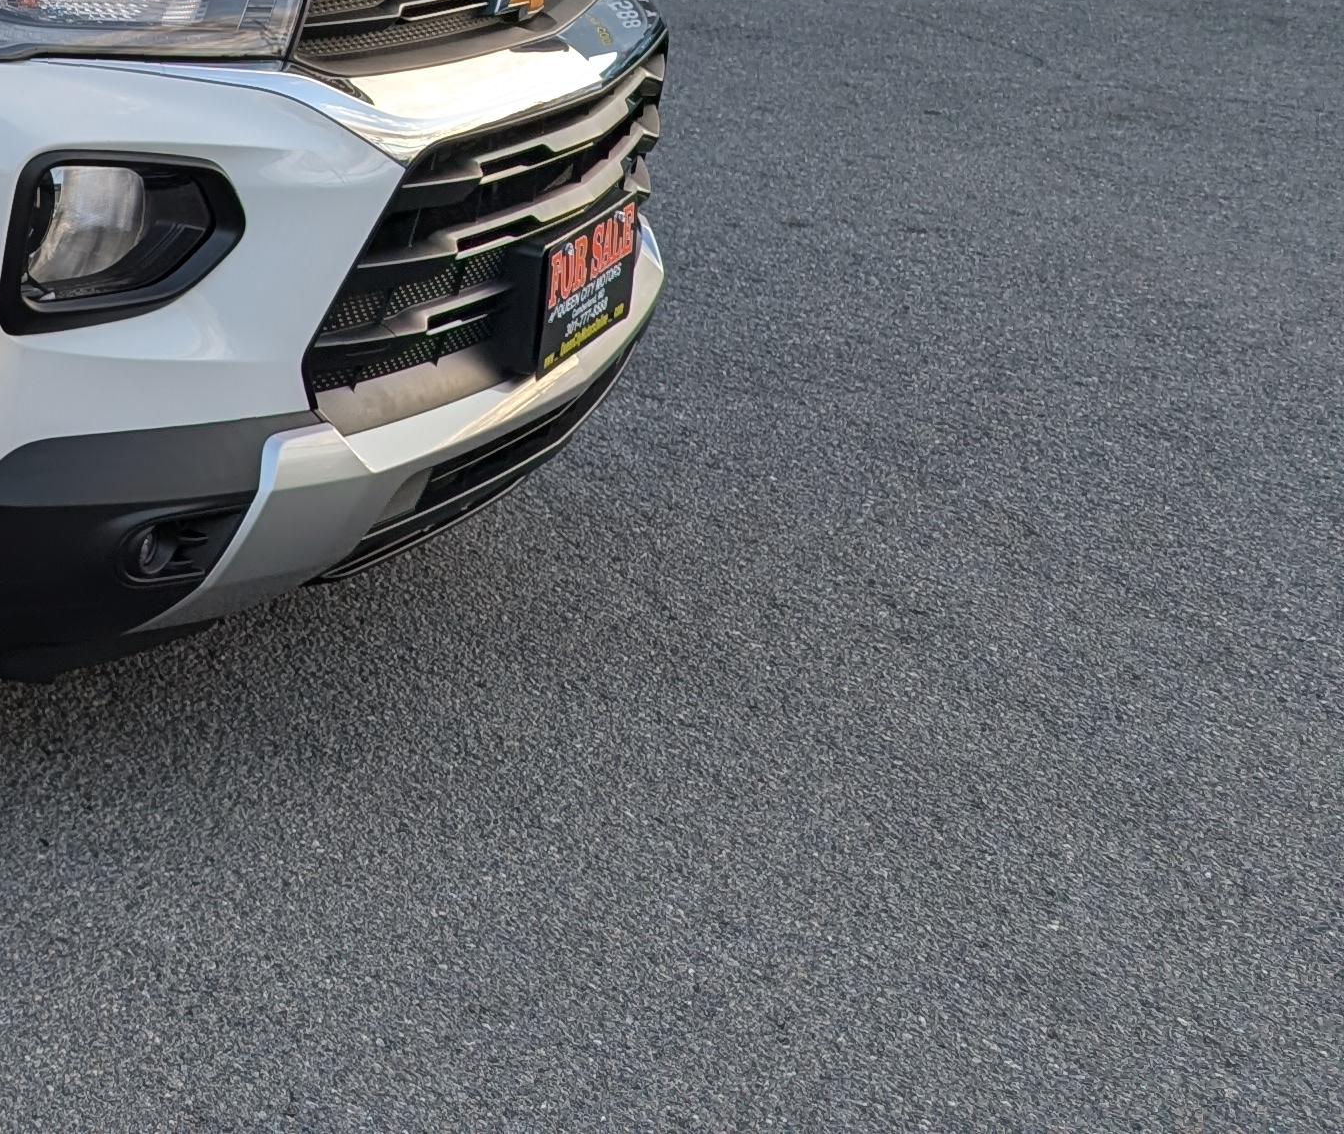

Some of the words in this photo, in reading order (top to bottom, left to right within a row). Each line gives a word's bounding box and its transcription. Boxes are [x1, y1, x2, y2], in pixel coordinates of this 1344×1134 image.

[548, 234, 588, 309] FOR
[590, 201, 636, 279] SALE
[557, 292, 581, 319] QUEEN
[580, 280, 596, 303] CITY
[595, 262, 623, 292] MOTORS
